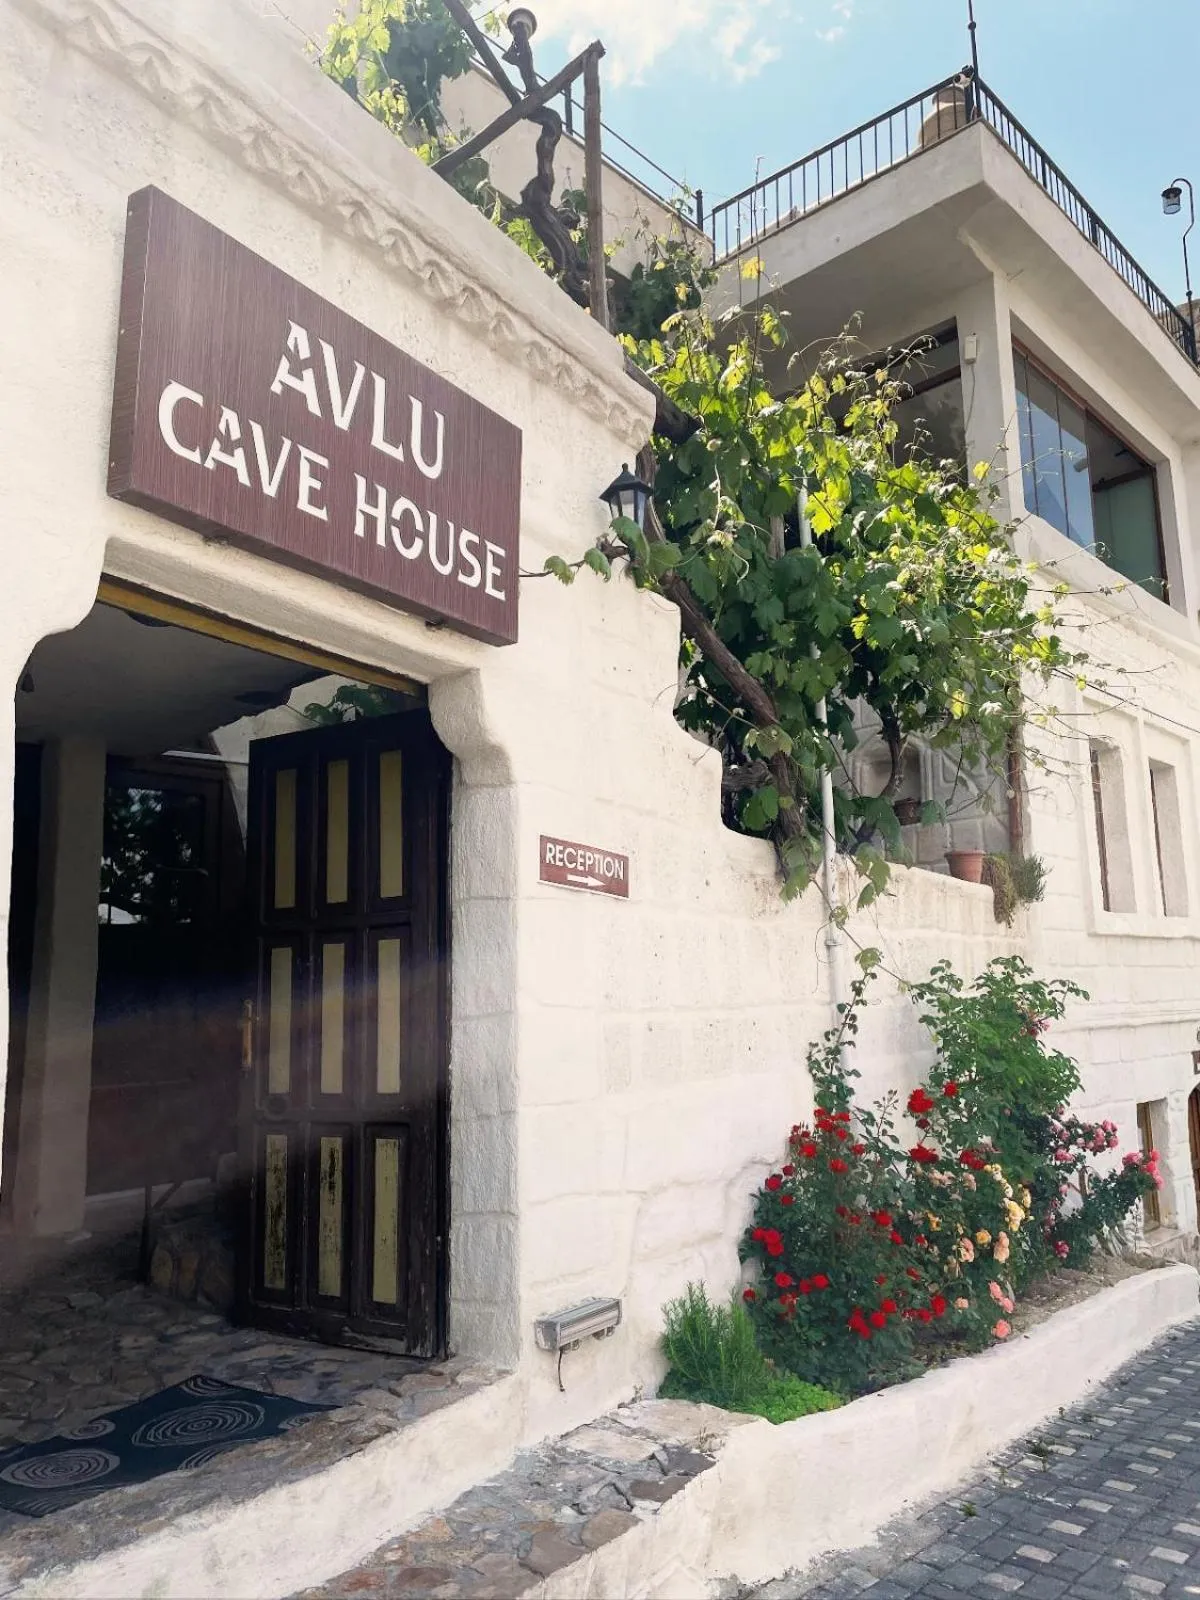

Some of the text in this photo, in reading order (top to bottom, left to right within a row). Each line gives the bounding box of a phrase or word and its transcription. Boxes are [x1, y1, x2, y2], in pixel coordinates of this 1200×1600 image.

[270, 319, 445, 479] AVLU
[158, 379, 506, 601] CAVE HOUSE
[545, 842, 624, 880] RECEPTION
